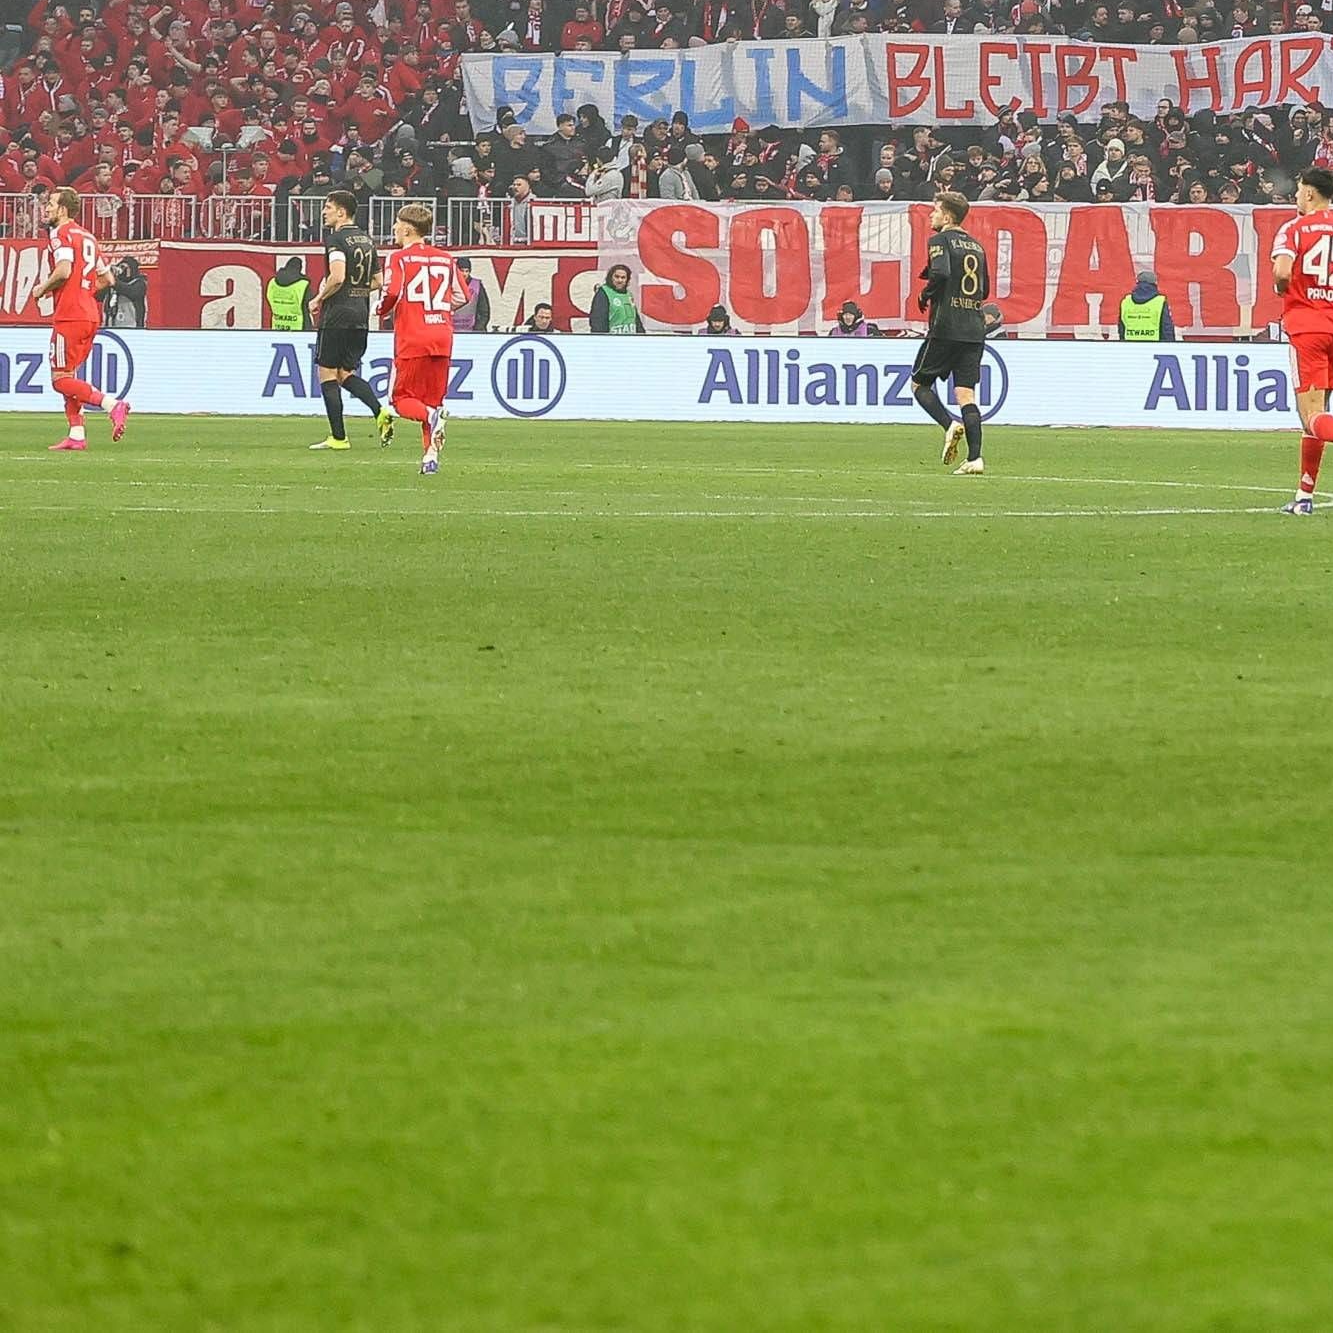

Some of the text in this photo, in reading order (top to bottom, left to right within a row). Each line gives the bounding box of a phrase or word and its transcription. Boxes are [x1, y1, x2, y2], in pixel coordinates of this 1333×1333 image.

[493, 46, 848, 128] BERLIN
[886, 41, 1136, 119] BLEIBT
[82, 237, 97, 278] 9
[350, 247, 373, 286] 31
[959, 254, 979, 296] 8
[407, 266, 451, 312] 42
[698, 348, 914, 407] Allianz
